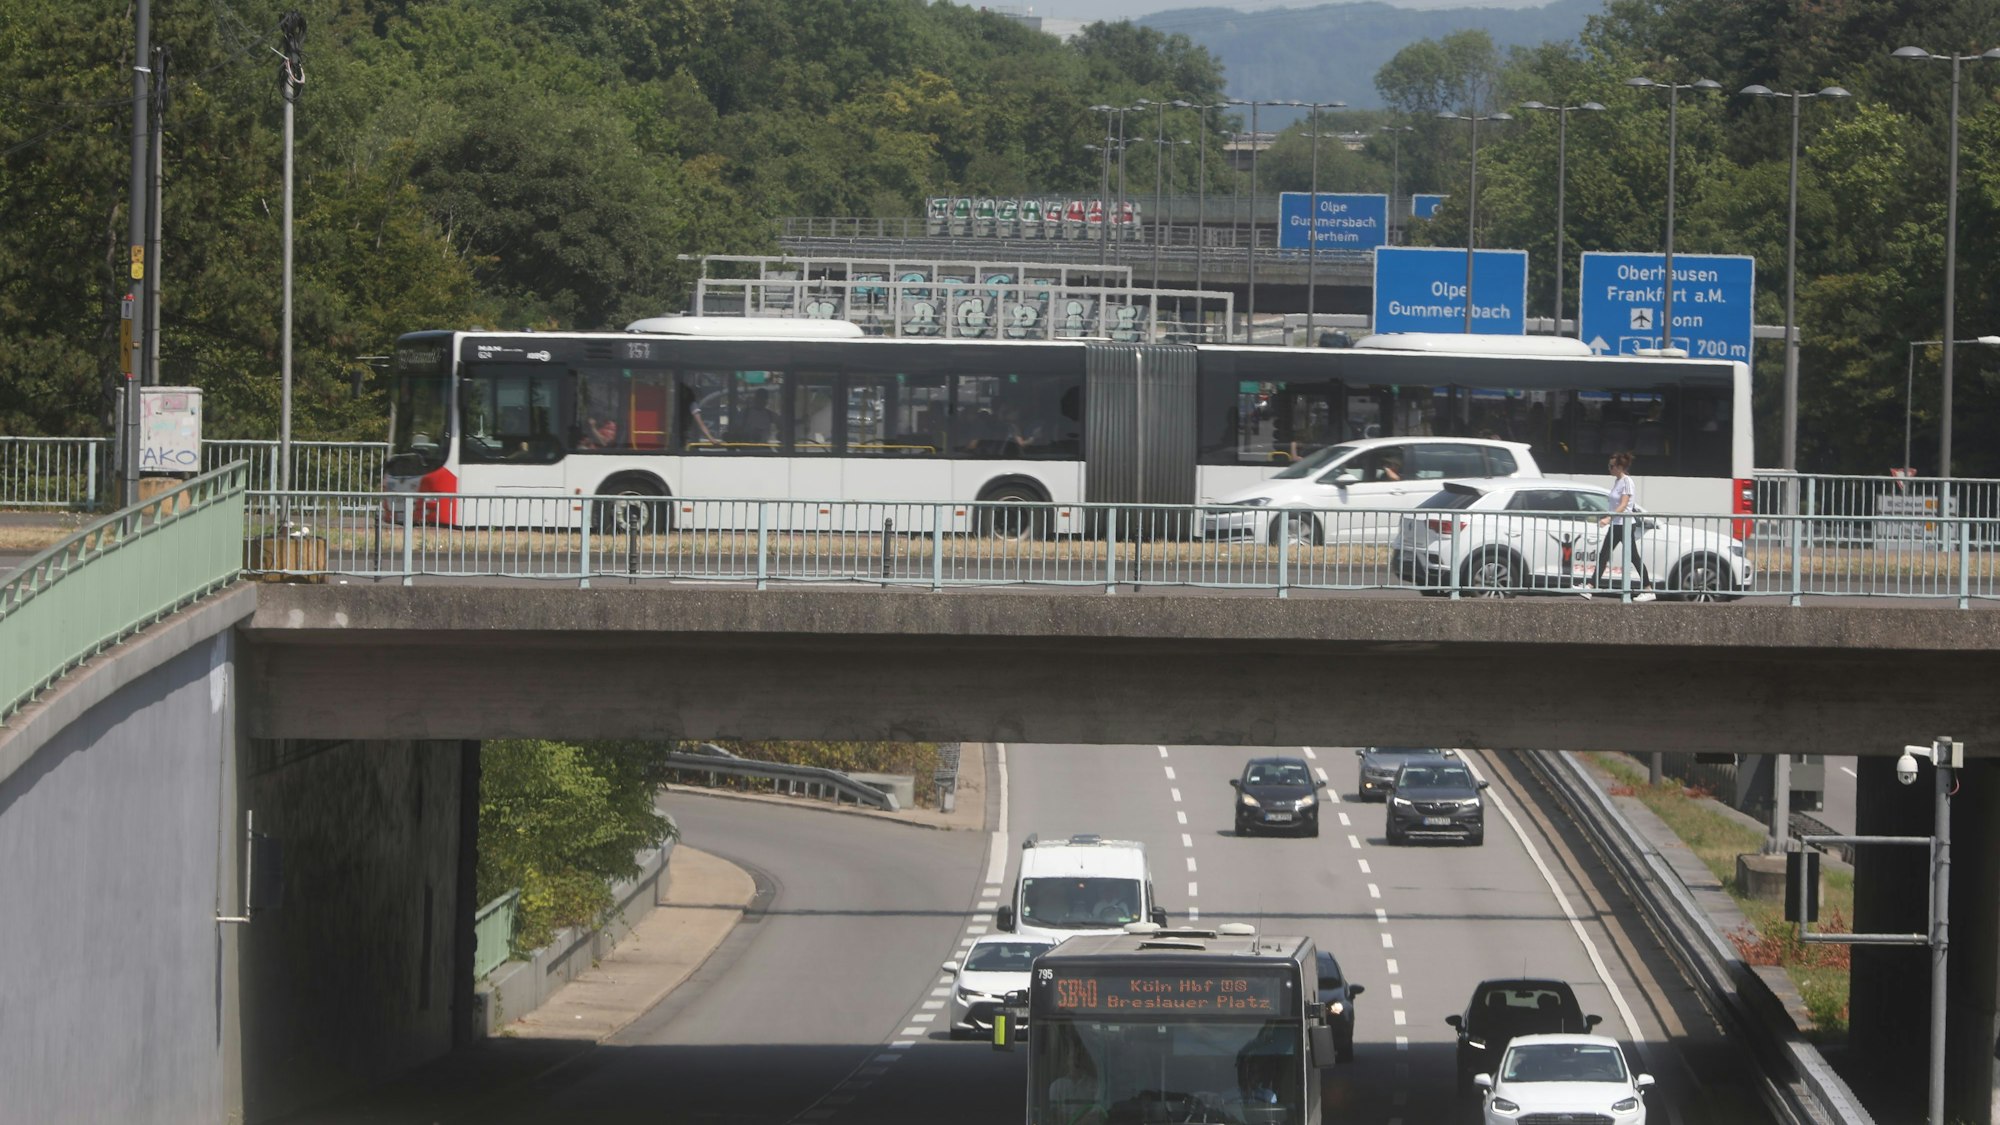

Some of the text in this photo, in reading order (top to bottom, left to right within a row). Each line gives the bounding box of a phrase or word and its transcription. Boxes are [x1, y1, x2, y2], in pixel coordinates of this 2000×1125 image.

[1320, 200, 1348, 215] Olpe
[1617, 264, 1718, 282] Oberhausen
[1431, 281, 1468, 300] Olpe
[1606, 285, 1727, 303] Frankfrt a.M.
[1660, 311, 1703, 328] onn
[1697, 339, 1746, 358] 700 m
[142, 446, 198, 466] AKO
[1038, 968, 1053, 980] 795
[1057, 979, 1098, 1008] SB40
[1130, 979, 1172, 992] Köln
[1179, 979, 1214, 992] Hbf
[1107, 994, 1271, 1009] Breslauer Platz
